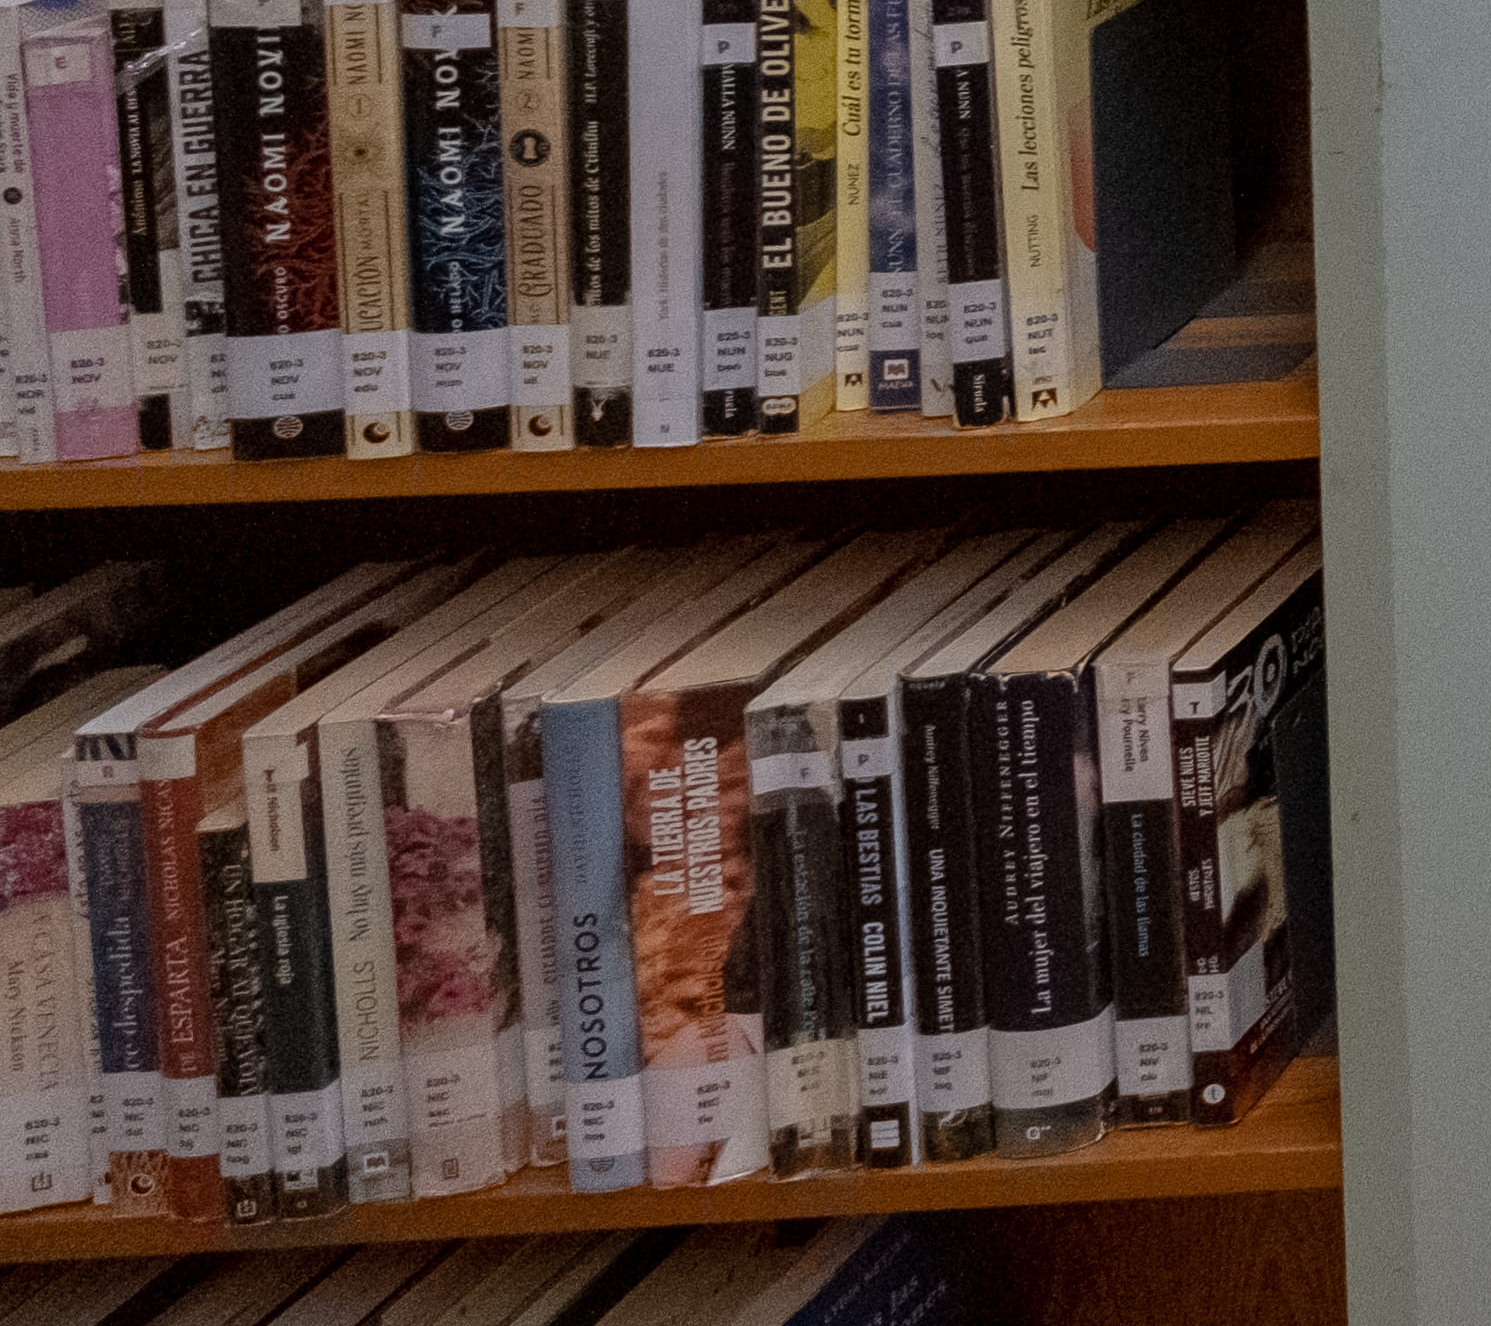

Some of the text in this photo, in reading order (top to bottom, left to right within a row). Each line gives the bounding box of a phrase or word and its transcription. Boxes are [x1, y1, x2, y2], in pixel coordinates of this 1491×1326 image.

[761, 88, 791, 122] DE
[843, 47, 862, 66] tu
[845, 70, 862, 91] es
[842, 94, 862, 137] Cuál
[1015, 73, 1038, 156] lecciones
[178, 50, 224, 284] CHICA EN GUERRA
[261, 133, 292, 243] NAOMI
[439, 127, 466, 234] NAOMI
[762, 134, 793, 227] BUENO
[1020, 161, 1040, 191] Las
[518, 184, 549, 299] GRADUADO
[762, 237, 793, 269] EL
[1026, 214, 1041, 268] NUTTING
[648, 765, 686, 897] LA TIERRA DE
[683, 736, 725, 915] NUESTROS PADRES
[1016, 699, 1055, 1014] La mujer del viajero en el tiempo
[855, 789, 888, 1023] LAS BESTIAS COLIN NIEL
[573, 912, 608, 1080] NOSOTROS
